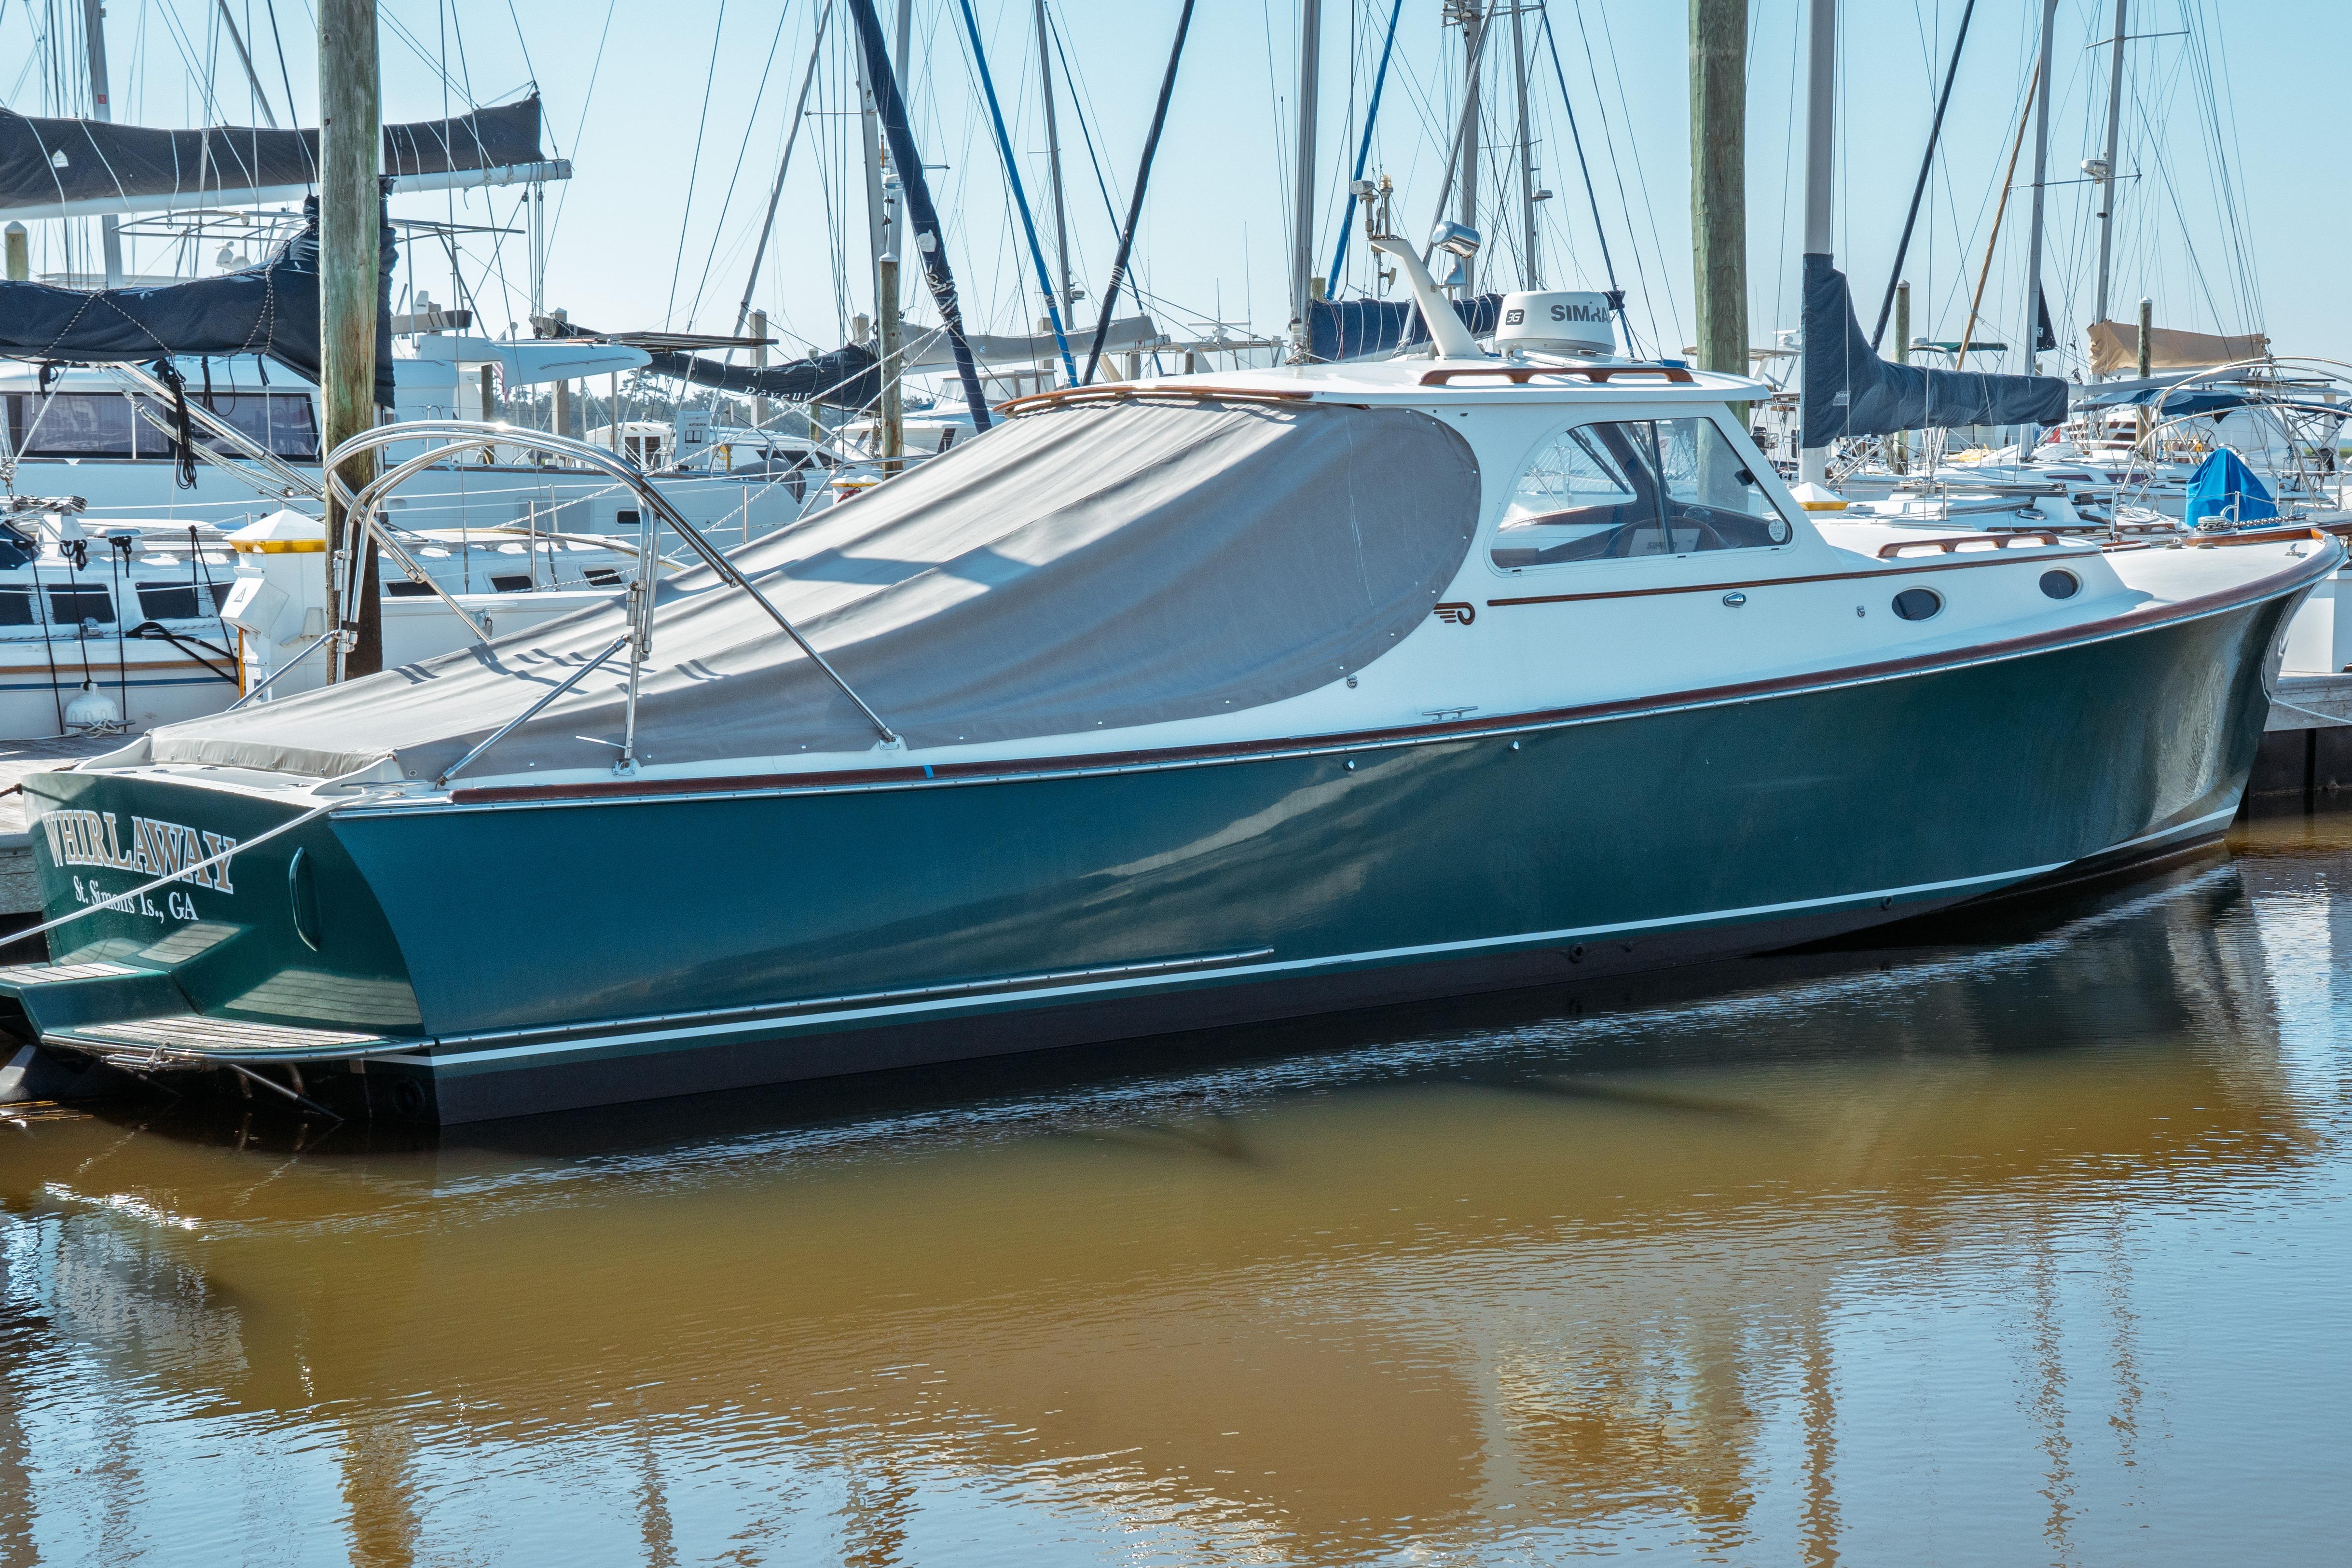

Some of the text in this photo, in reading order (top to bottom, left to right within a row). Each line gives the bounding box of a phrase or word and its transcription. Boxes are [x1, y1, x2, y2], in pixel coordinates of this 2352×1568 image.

[1507, 312, 1522, 323] 3G
[41, 810, 236, 894] WHIRLAWAY
[73, 875, 89, 904] St.
[169, 892, 199, 921] GA
